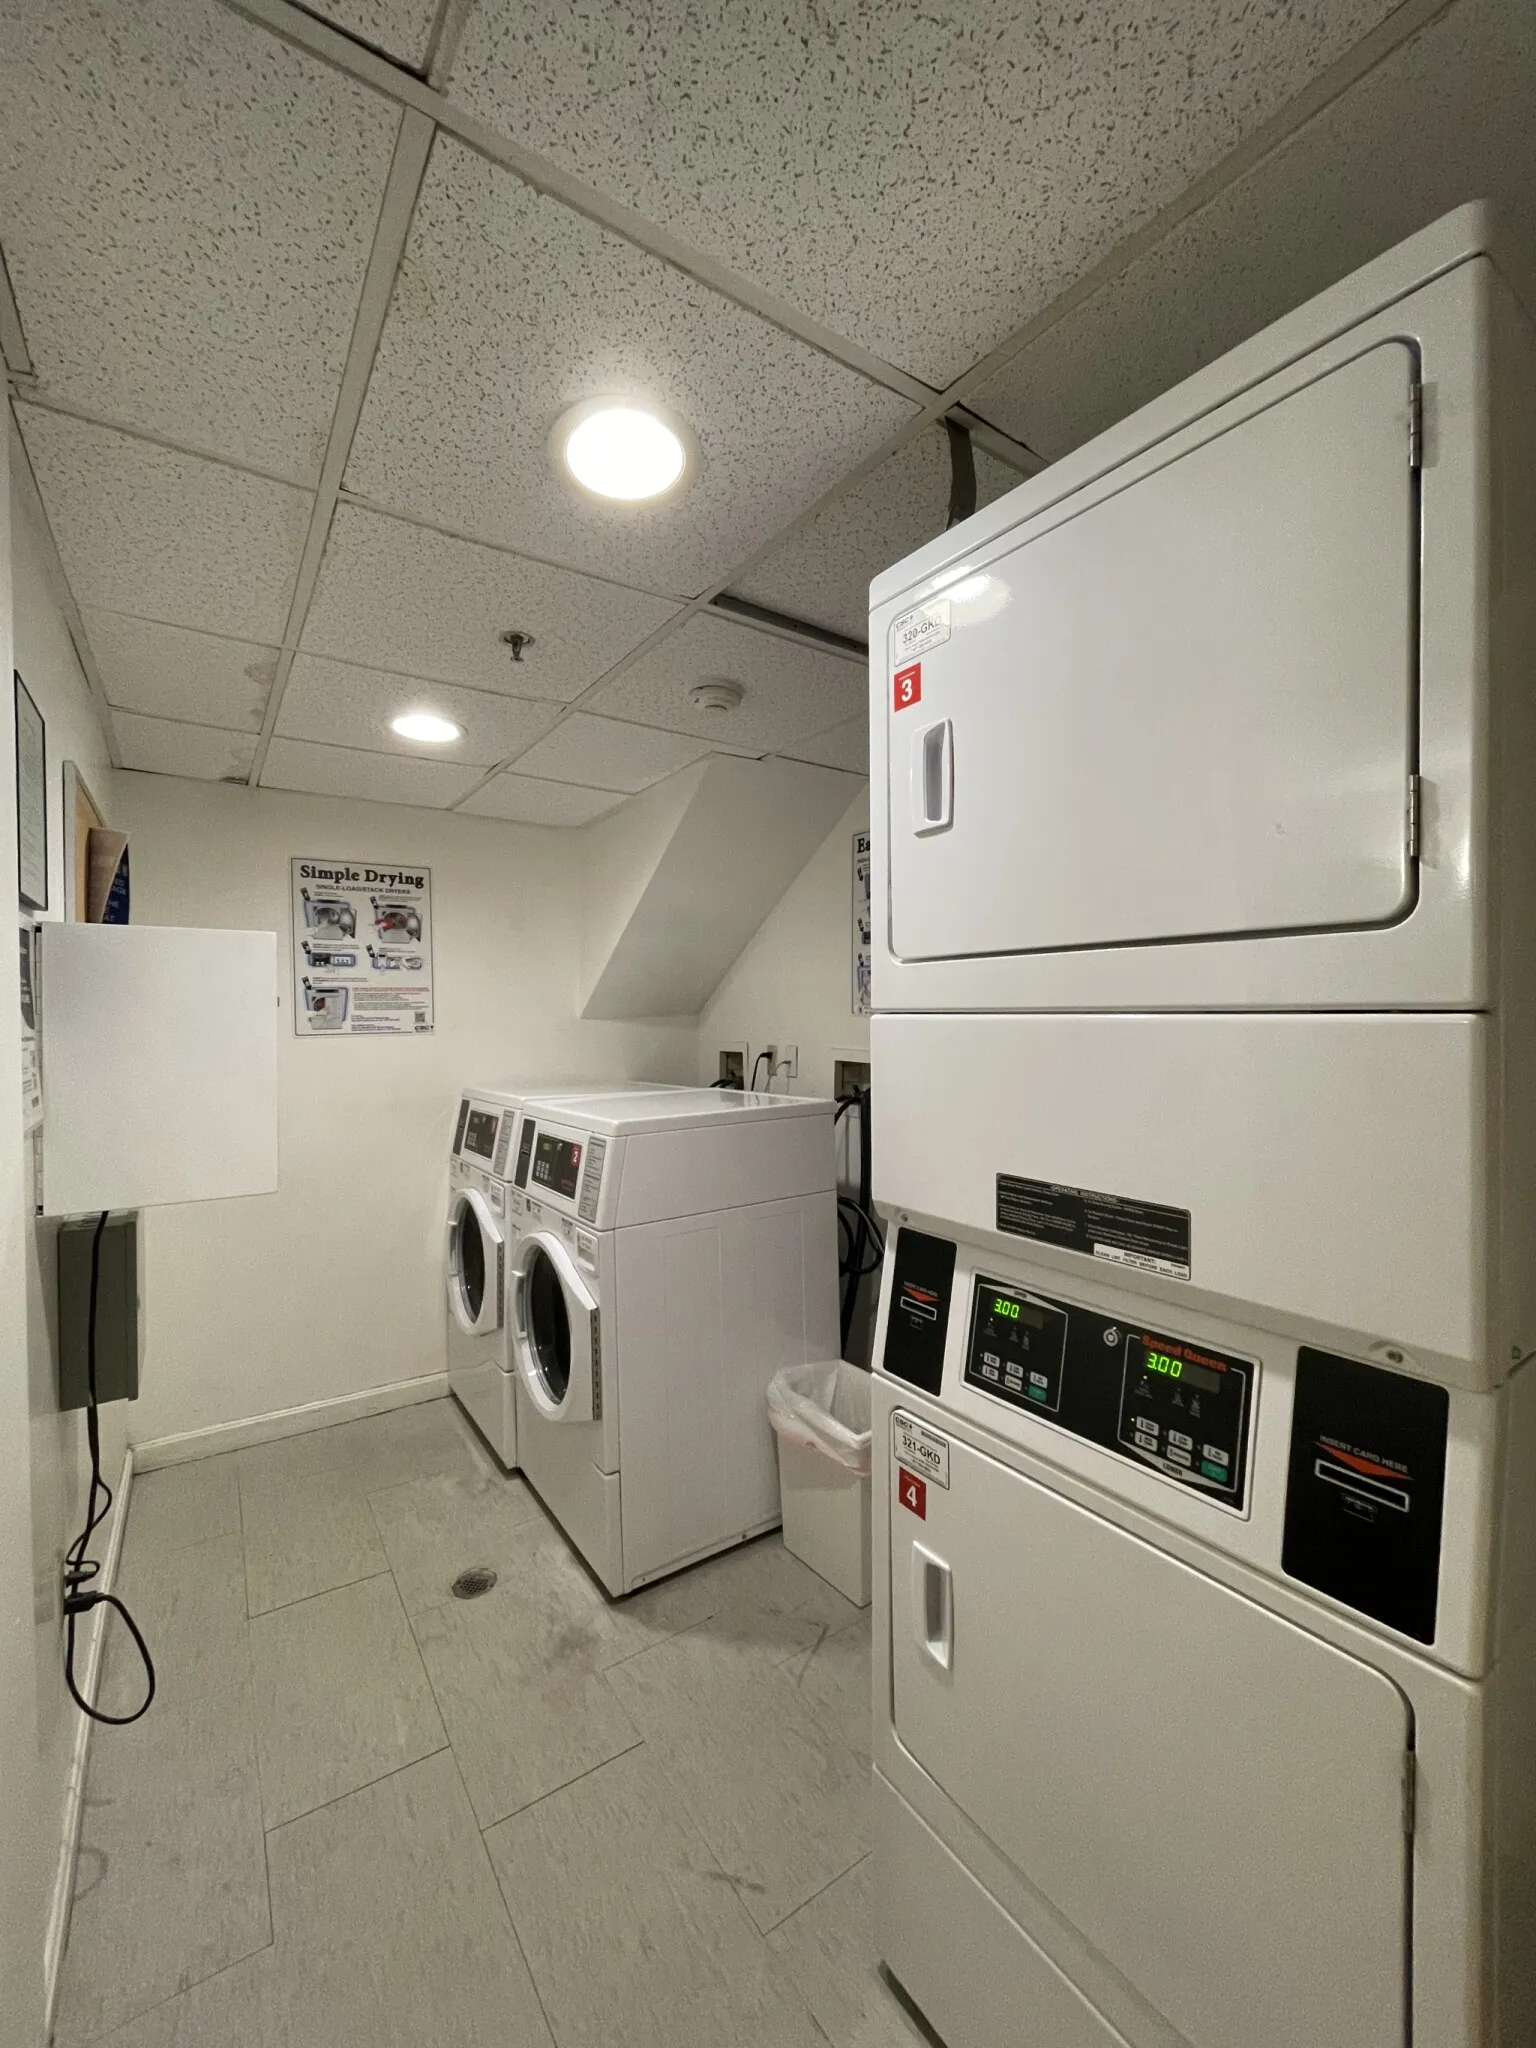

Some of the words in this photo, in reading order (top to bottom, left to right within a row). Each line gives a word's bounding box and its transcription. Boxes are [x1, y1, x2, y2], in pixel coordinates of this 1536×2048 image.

[901, 678, 912, 702] 3
[300, 864, 360, 884] Simple
[364, 869, 424, 889] Drying
[1142, 1335, 1183, 1357] Speed
[1183, 1348, 1228, 1372] Queen
[1147, 1352, 1183, 1378] 3.00
[902, 1435, 941, 1464] 321-GKD
[1320, 1435, 1352, 1452] INSERT
[1353, 1447, 1380, 1464] CARD
[1381, 1457, 1408, 1474] HERE
[906, 1485, 918, 1507] 4
